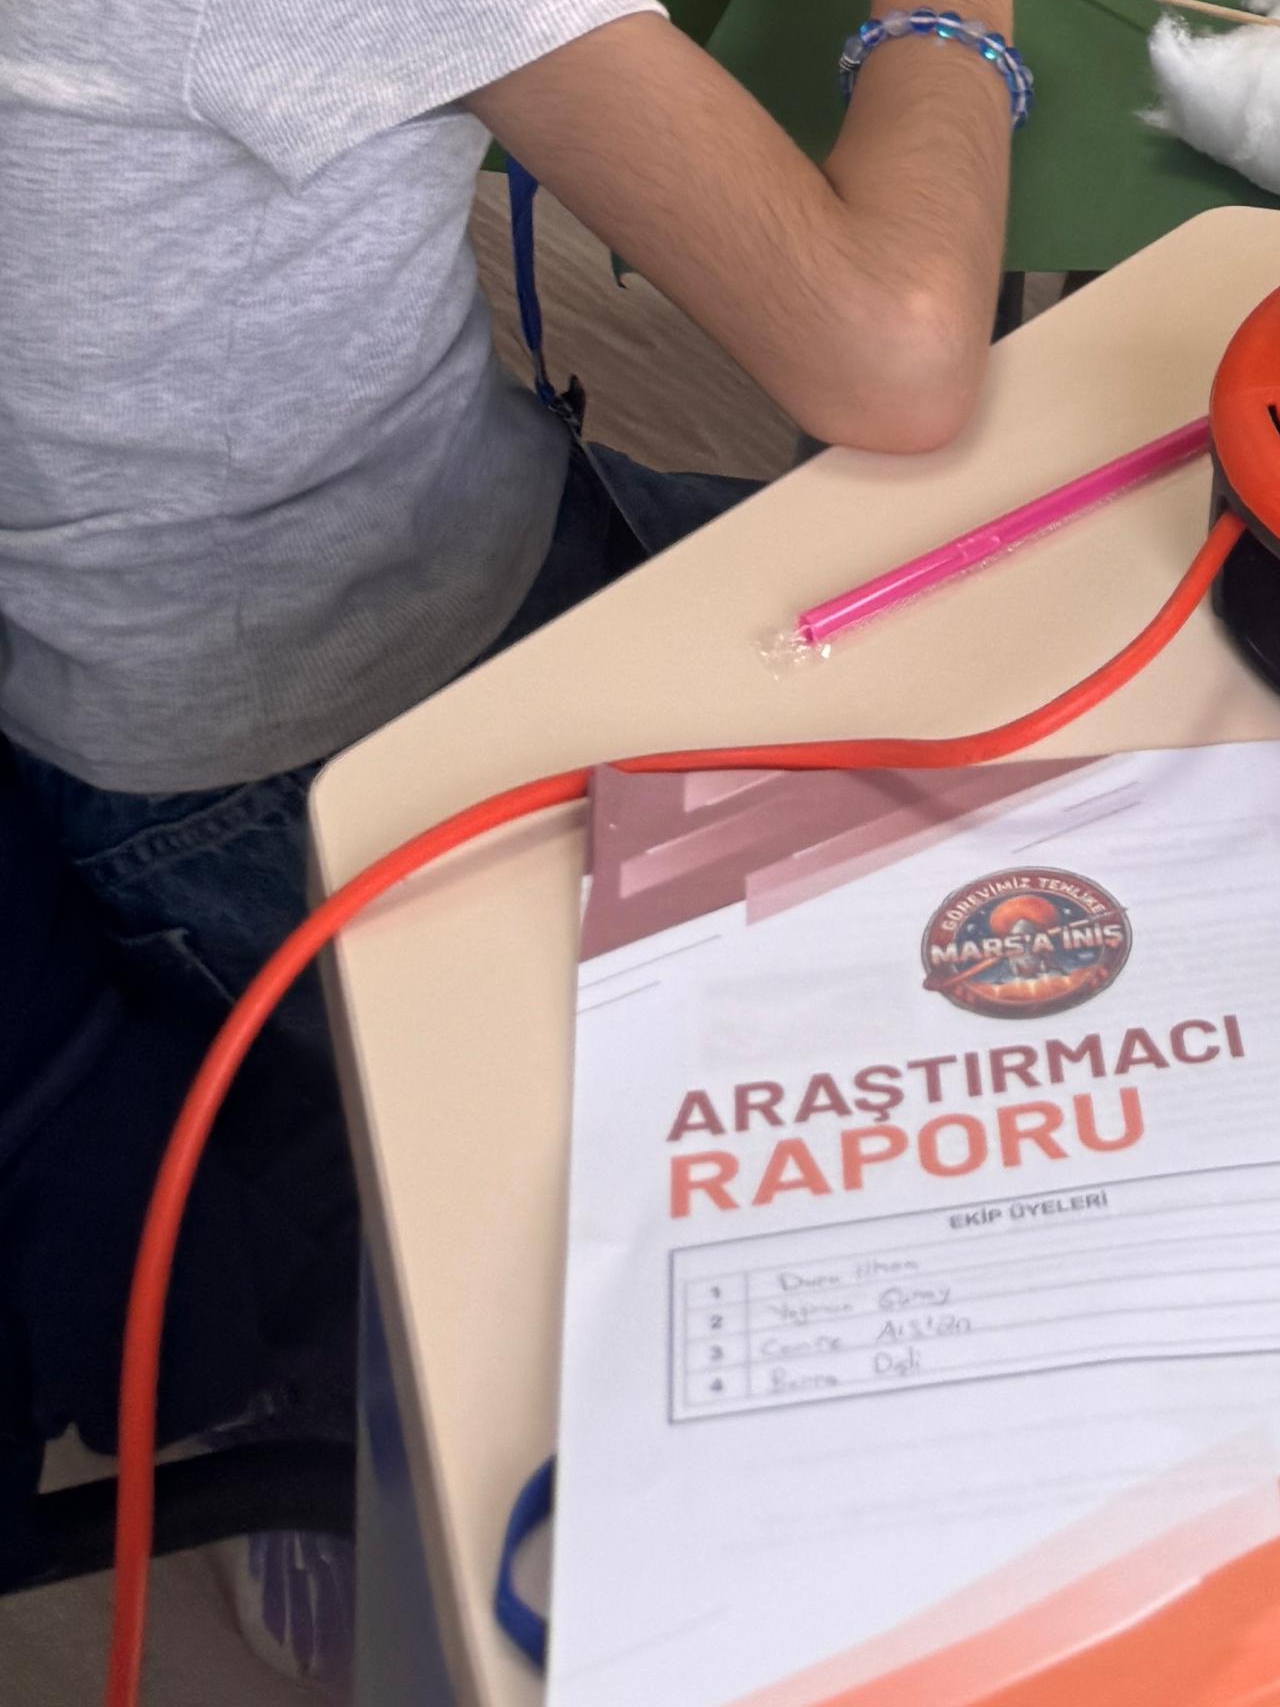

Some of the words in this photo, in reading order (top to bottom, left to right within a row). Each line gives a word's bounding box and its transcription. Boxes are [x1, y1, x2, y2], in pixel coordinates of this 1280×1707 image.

[666, 1014, 1246, 1142] ARAŞTIRMACI
[669, 1087, 1145, 1219] RAPORU
[949, 1206, 1002, 1229] EKİP
[1009, 1190, 1109, 1220] ÜYELERİ
